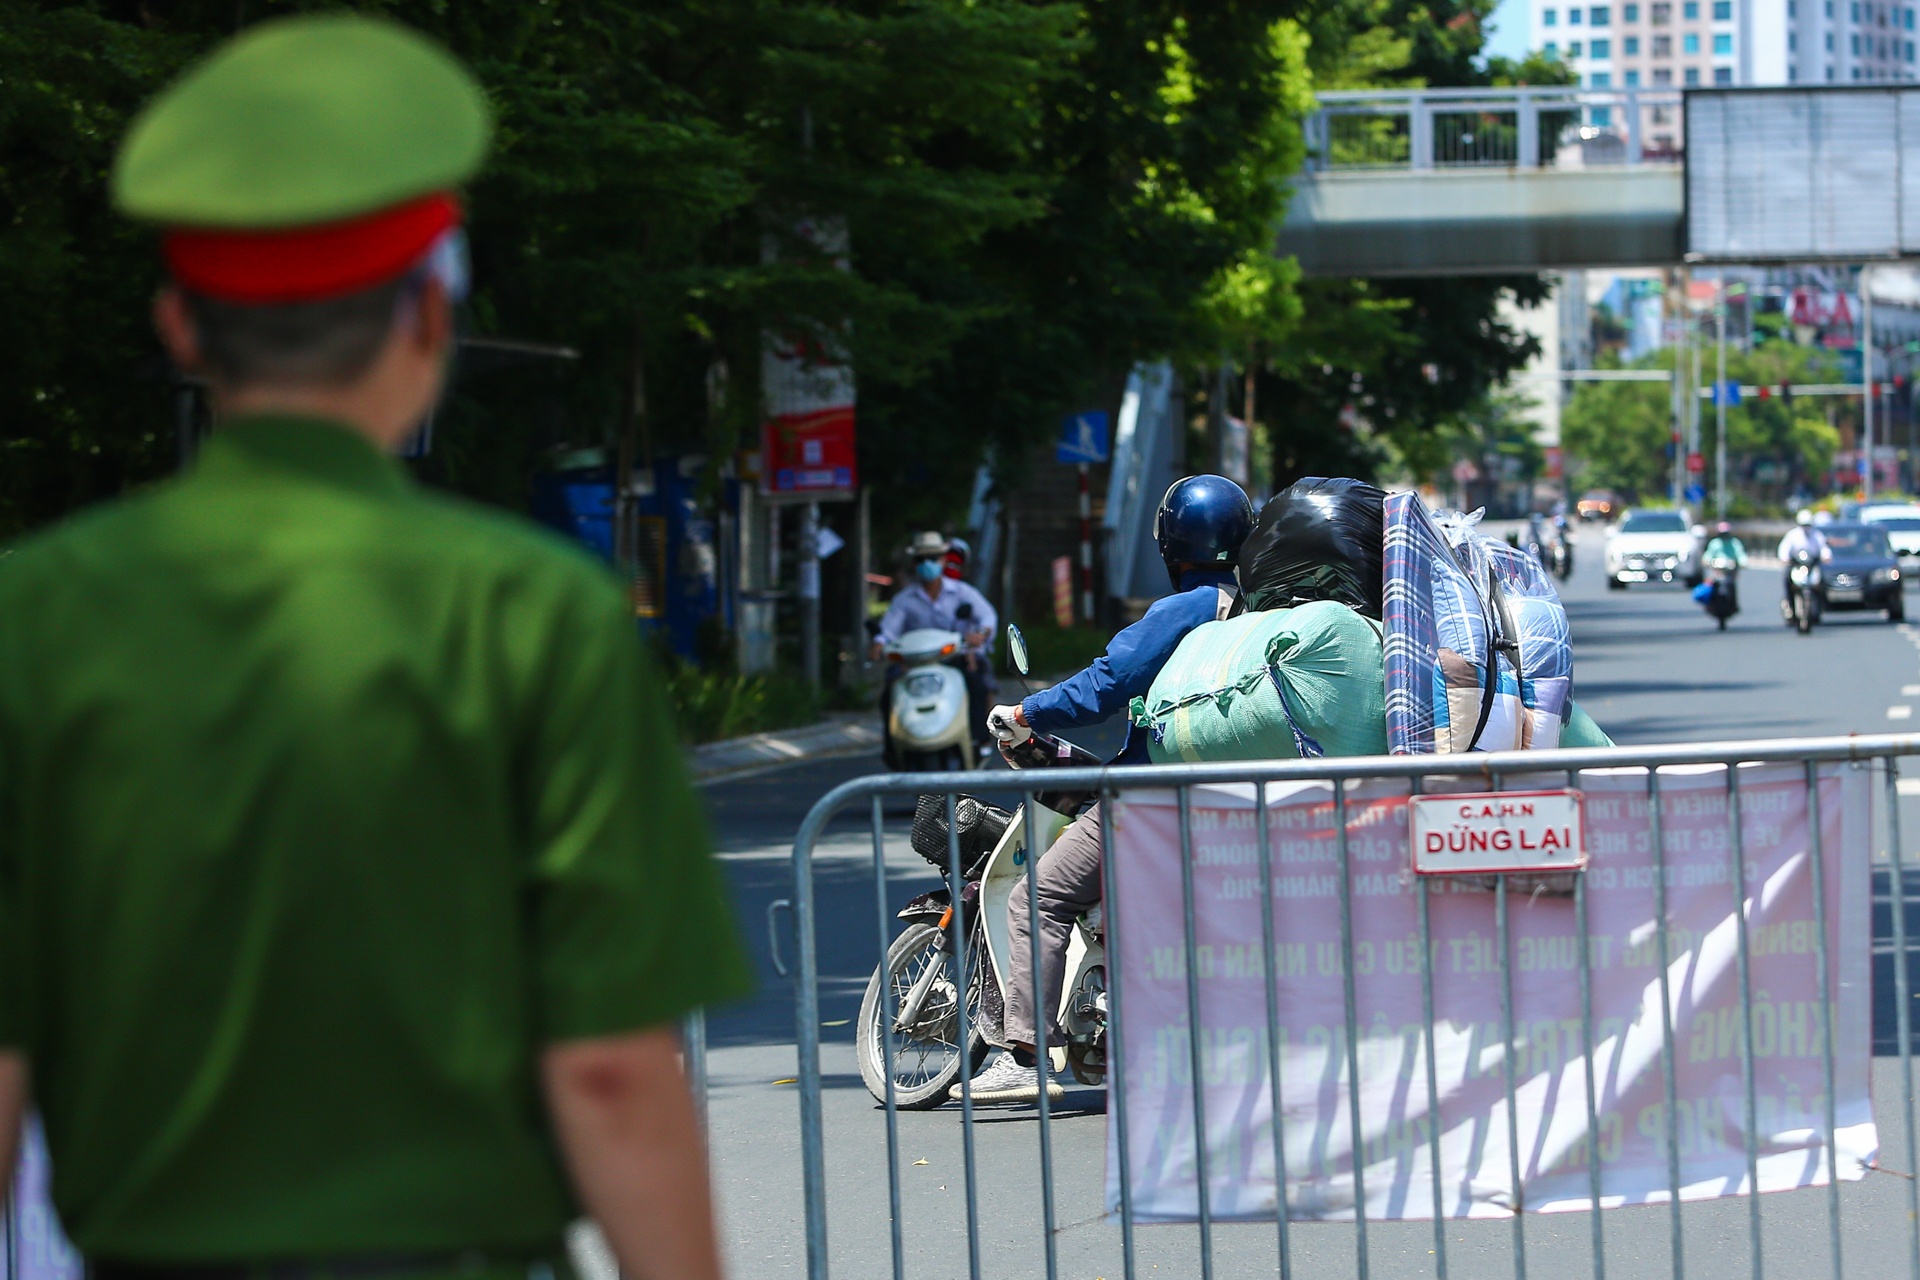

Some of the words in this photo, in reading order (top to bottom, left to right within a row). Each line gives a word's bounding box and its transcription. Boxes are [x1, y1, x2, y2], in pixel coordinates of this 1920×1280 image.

[1459, 803, 1534, 819] C.A.H.N
[1425, 824, 1512, 853] DỪNG
[1519, 827, 1570, 854] LẠI
